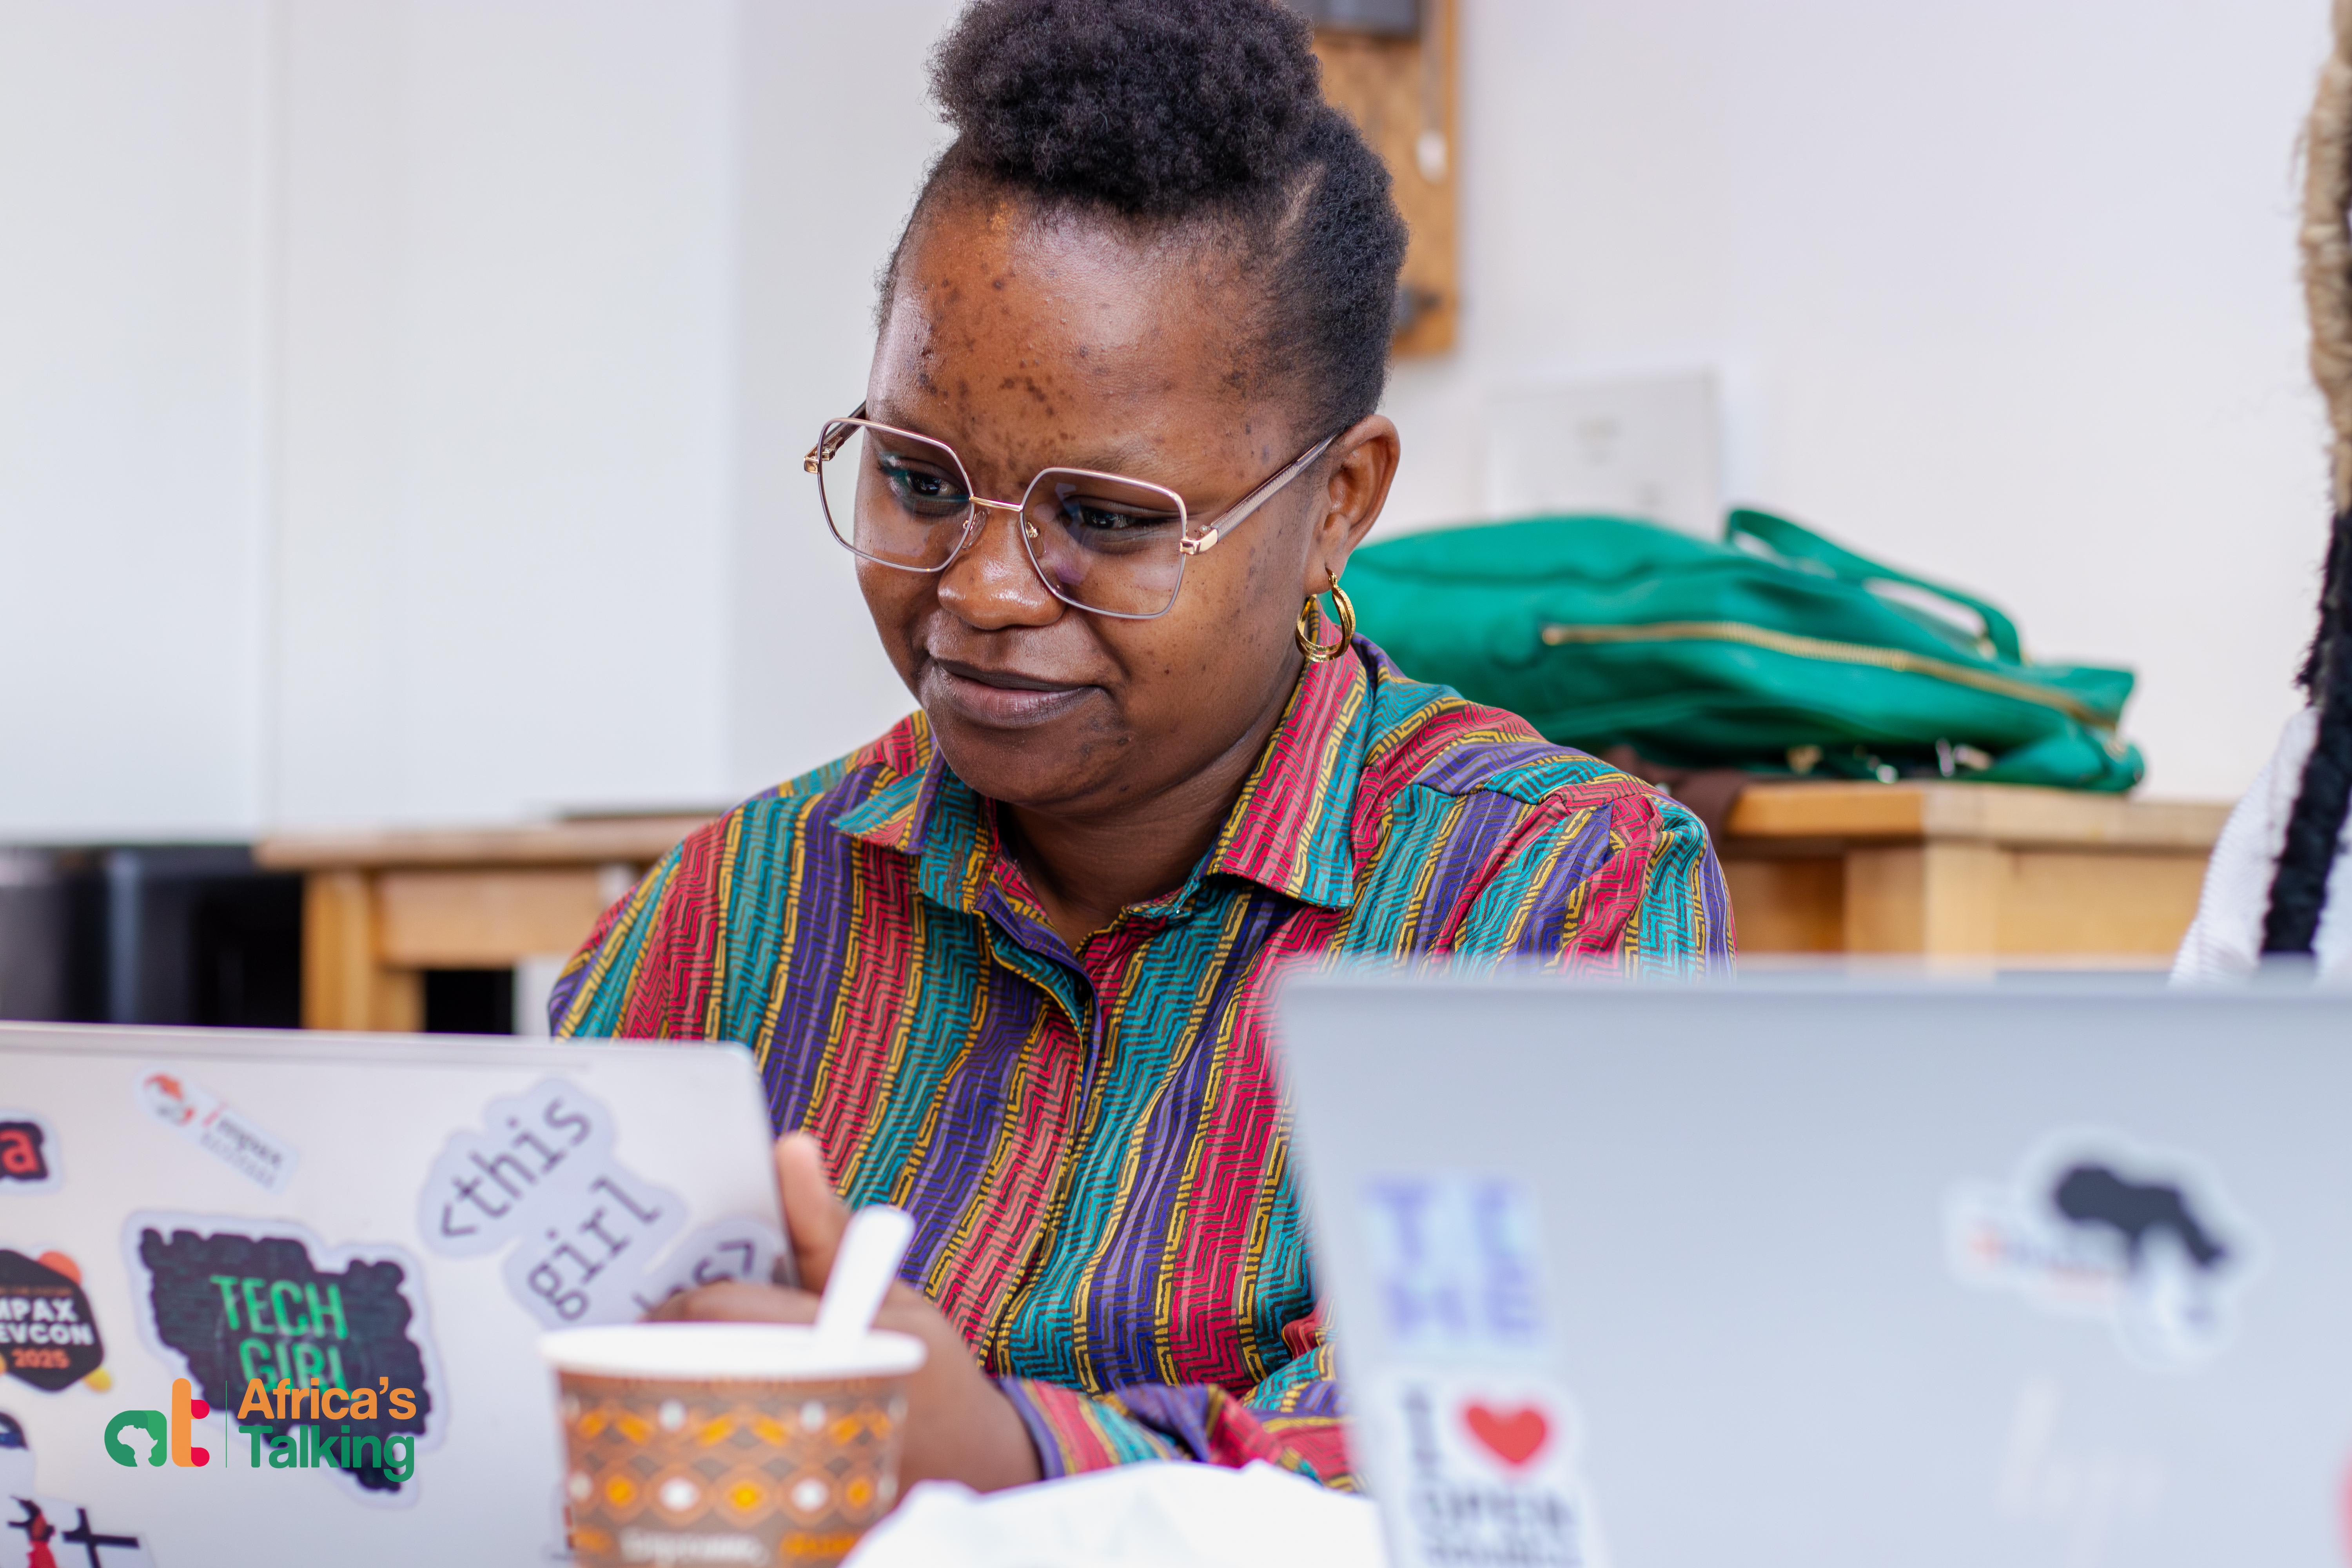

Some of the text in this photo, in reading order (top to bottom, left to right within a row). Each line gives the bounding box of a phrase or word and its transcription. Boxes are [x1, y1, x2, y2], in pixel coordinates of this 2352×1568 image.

[440, 1097, 593, 1239] <this
[528, 1176, 662, 1321] girl
[210, 1274, 348, 1340] TECH
[11, 1347, 71, 1369] 2025
[239, 1337, 361, 1401] GIRL
